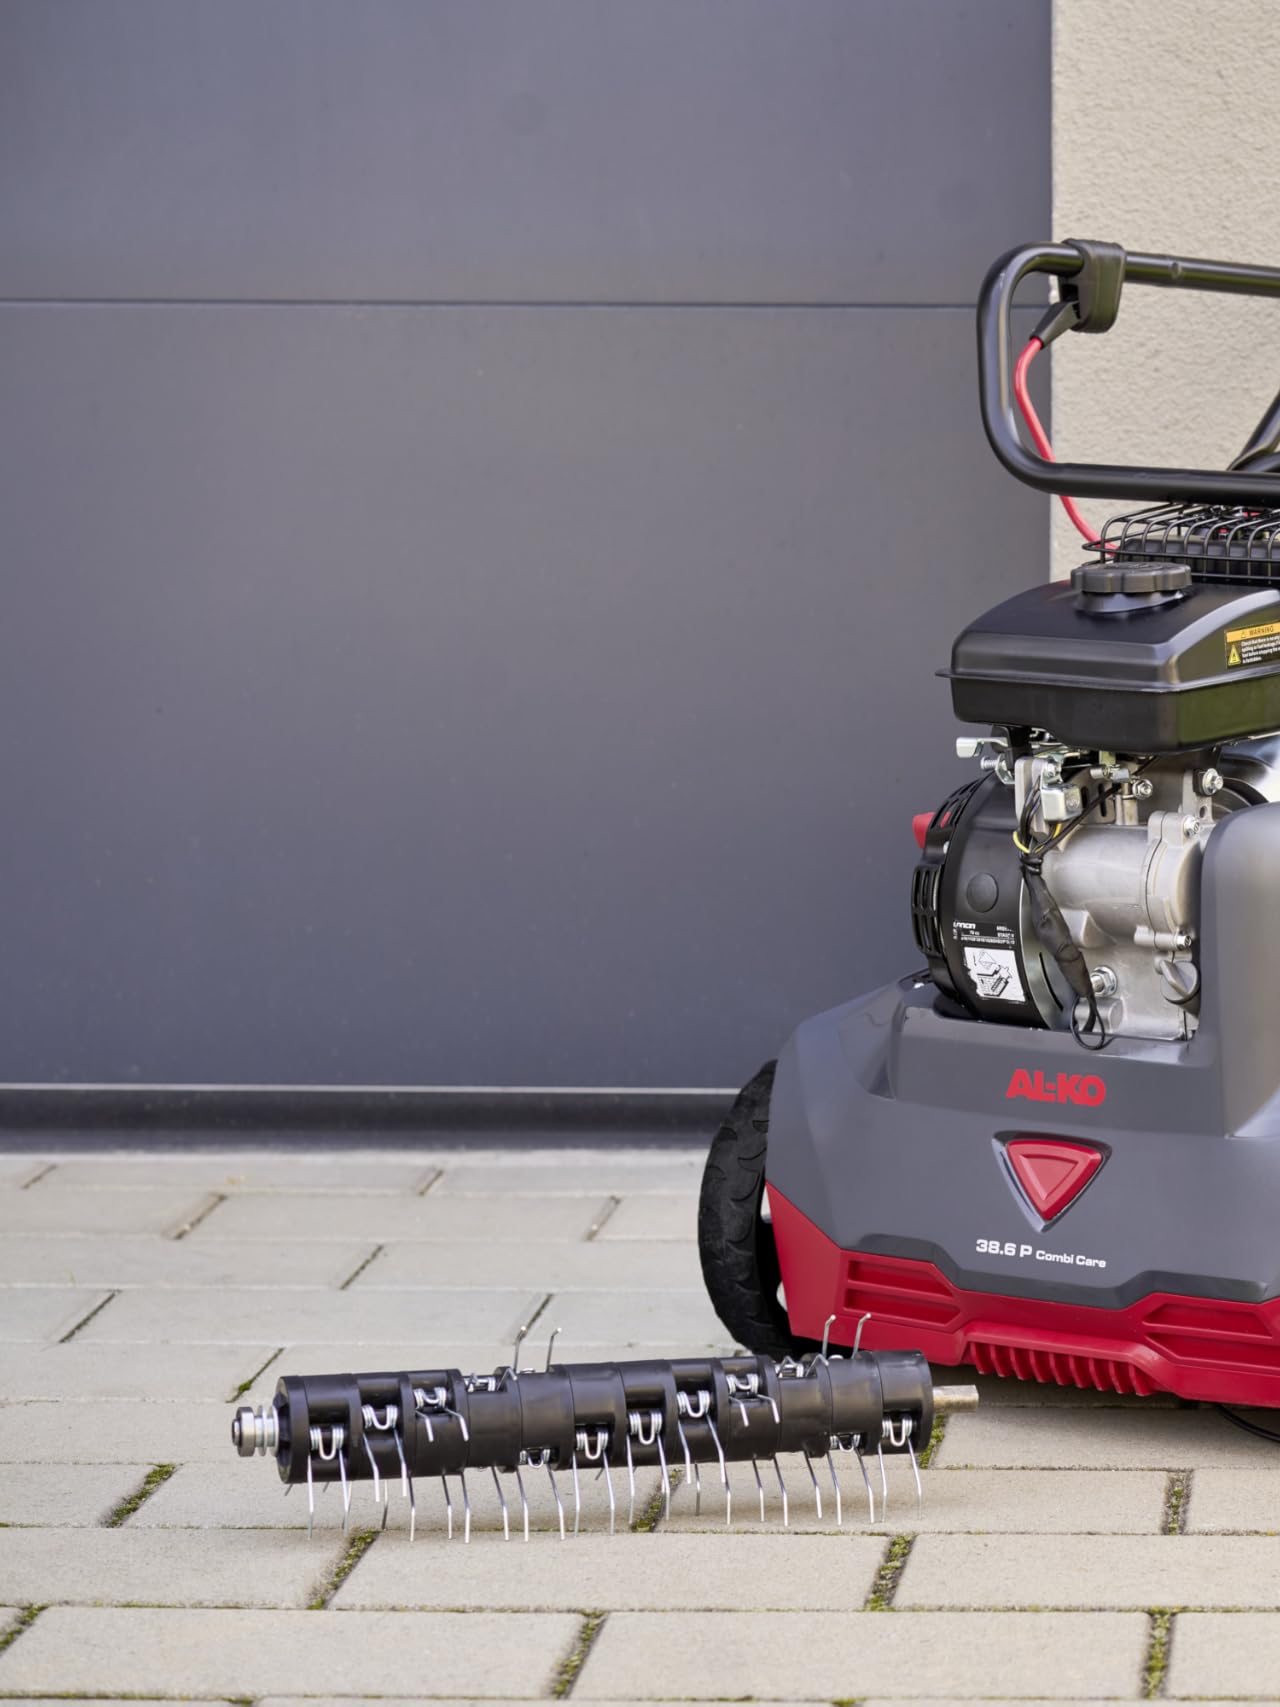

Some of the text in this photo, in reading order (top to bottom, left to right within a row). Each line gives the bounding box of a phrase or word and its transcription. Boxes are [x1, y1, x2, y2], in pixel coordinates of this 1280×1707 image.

[1250, 625, 1273, 636] WARNING
[1006, 1068, 1106, 1107] AL-KO
[975, 1239, 1106, 1268] 38.6 P Combi Care
